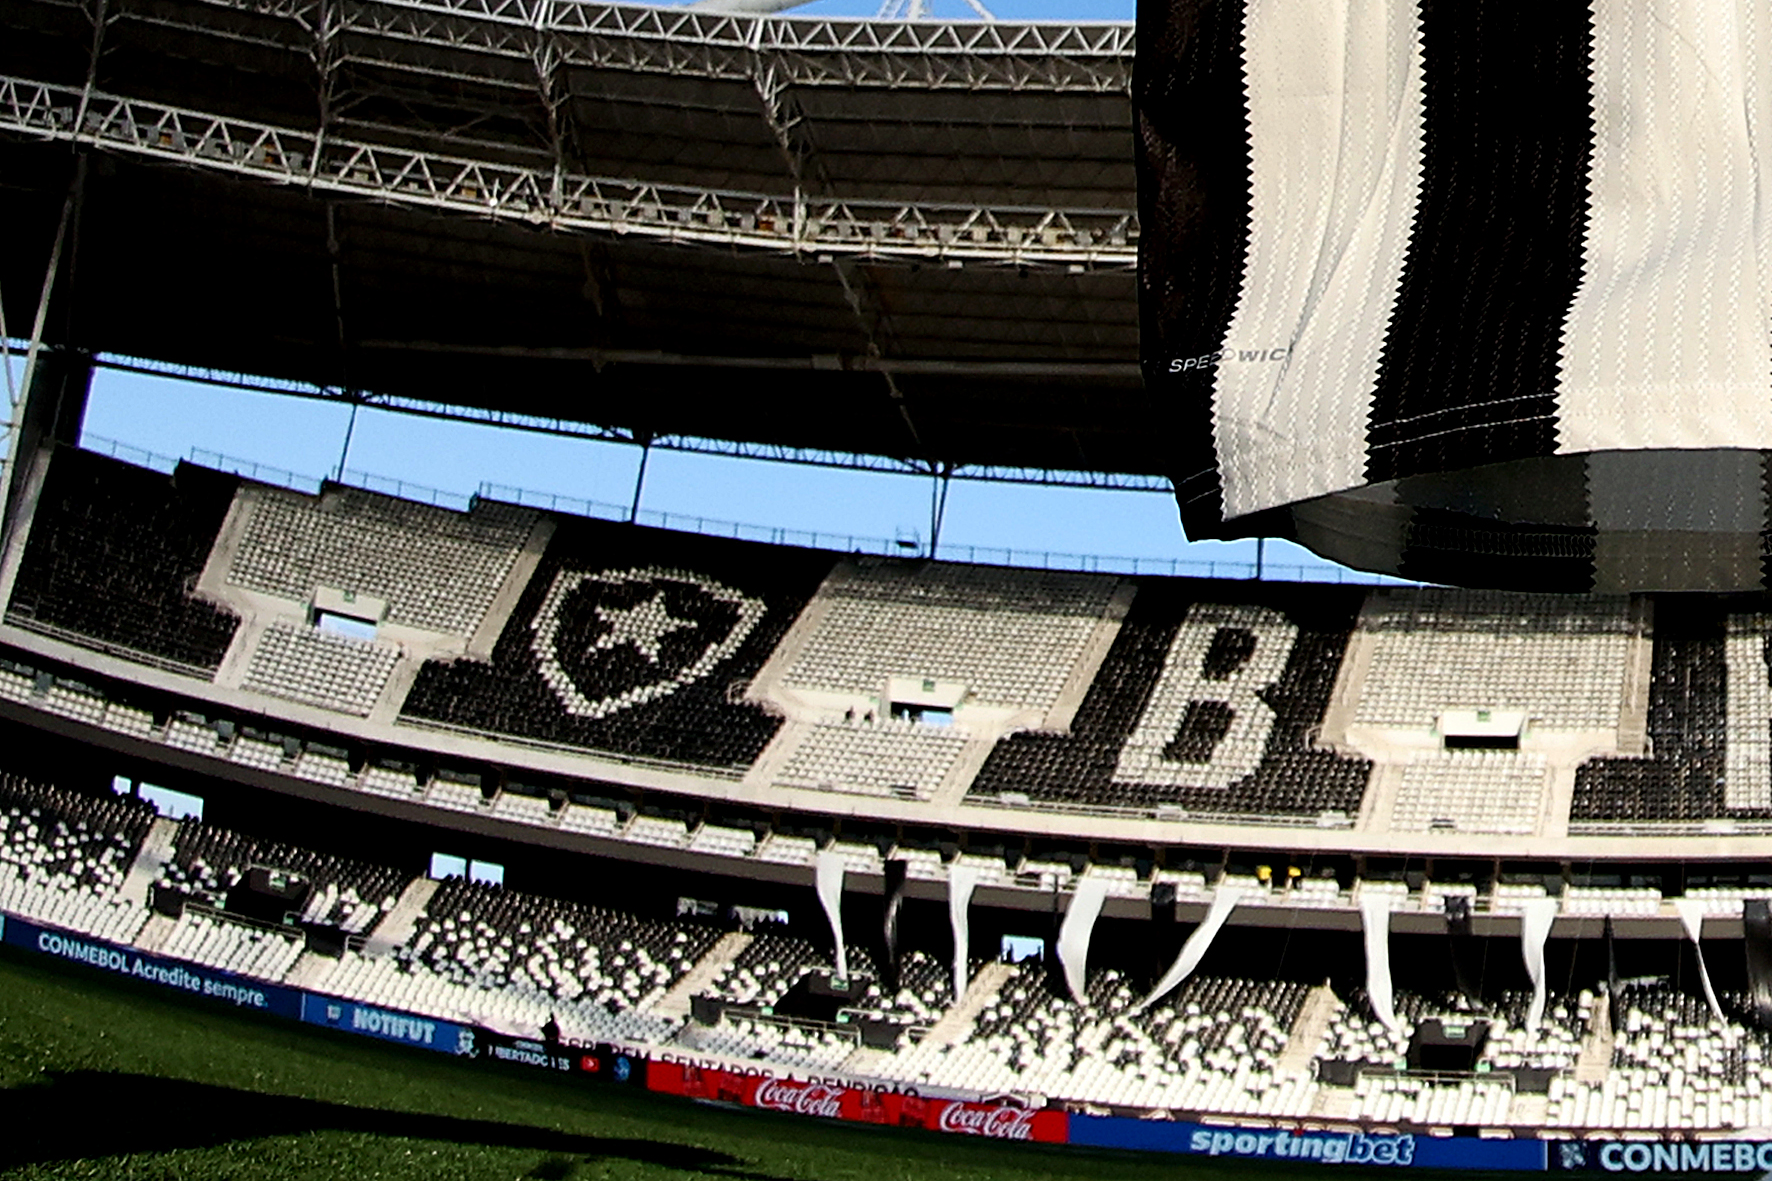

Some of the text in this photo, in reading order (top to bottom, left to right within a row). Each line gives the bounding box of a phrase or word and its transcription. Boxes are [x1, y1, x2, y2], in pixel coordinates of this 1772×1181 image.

[1168, 347, 1292, 373] SPEEDWIC
[38, 931, 130, 973] CONMEBOL
[131, 958, 201, 991] Acredite
[352, 1007, 436, 1044] NOTIFUT
[1190, 1129, 1417, 1165] sportingbet
